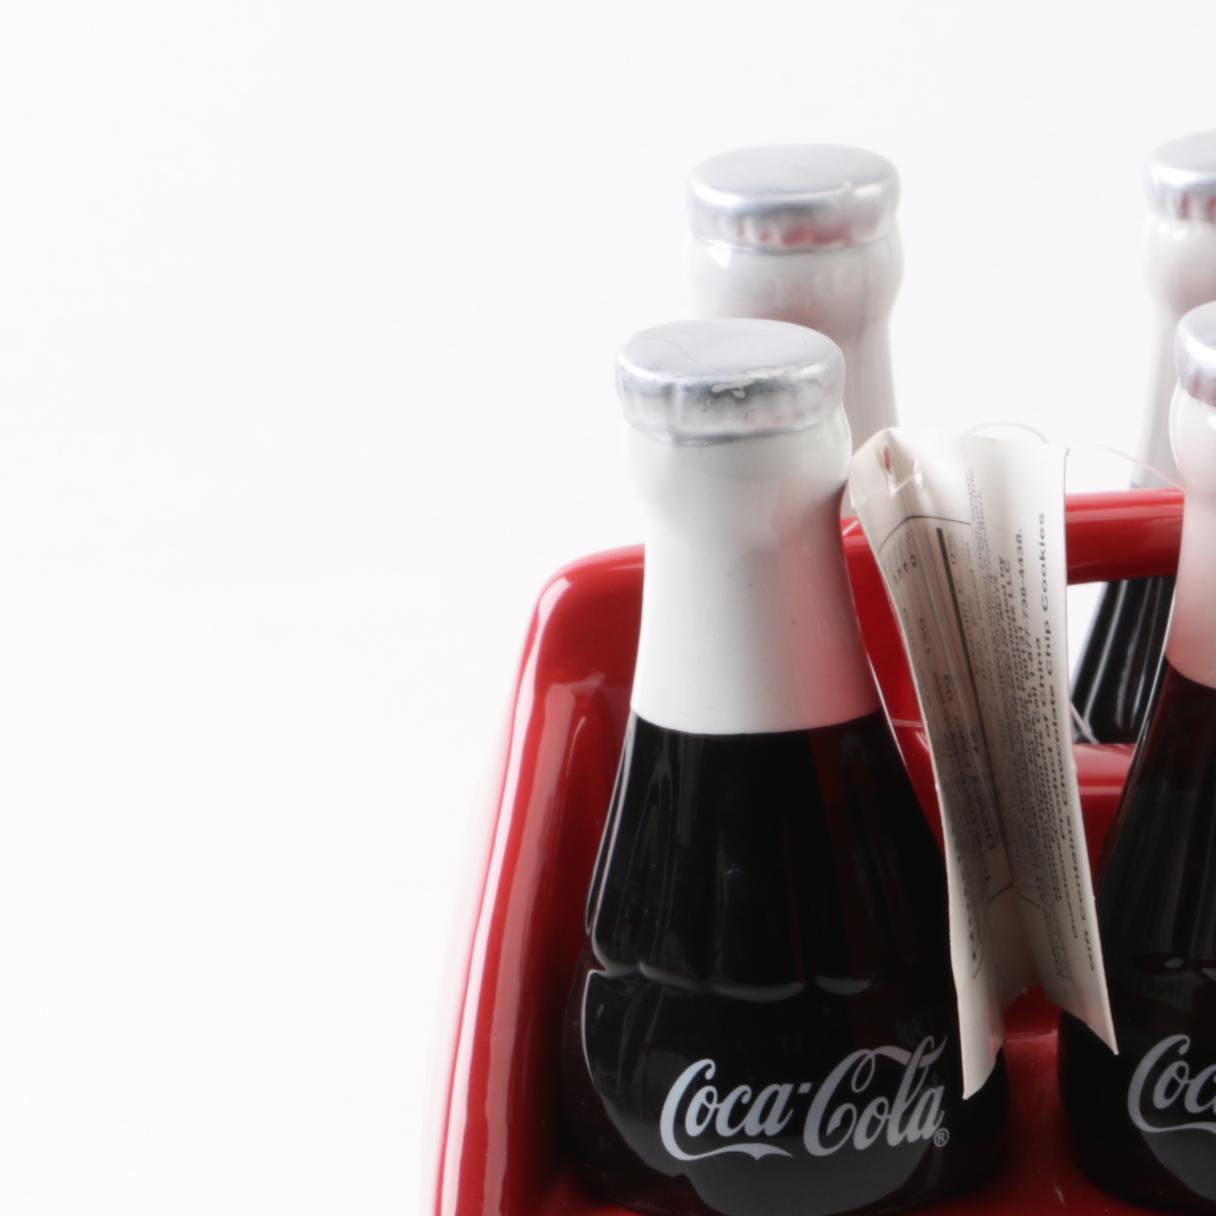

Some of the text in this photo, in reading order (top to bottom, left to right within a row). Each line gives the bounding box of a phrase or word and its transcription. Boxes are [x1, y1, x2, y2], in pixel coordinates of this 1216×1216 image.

[1004, 559, 1014, 600] LLC
[1038, 512, 1049, 613] Cookies
[1044, 619, 1053, 677] Chip
[1031, 686, 1041, 723] Call
[1035, 638, 1066, 840] Product of China
[1049, 685, 1069, 808] Chocolate
[1065, 815, 1087, 922] Contains
